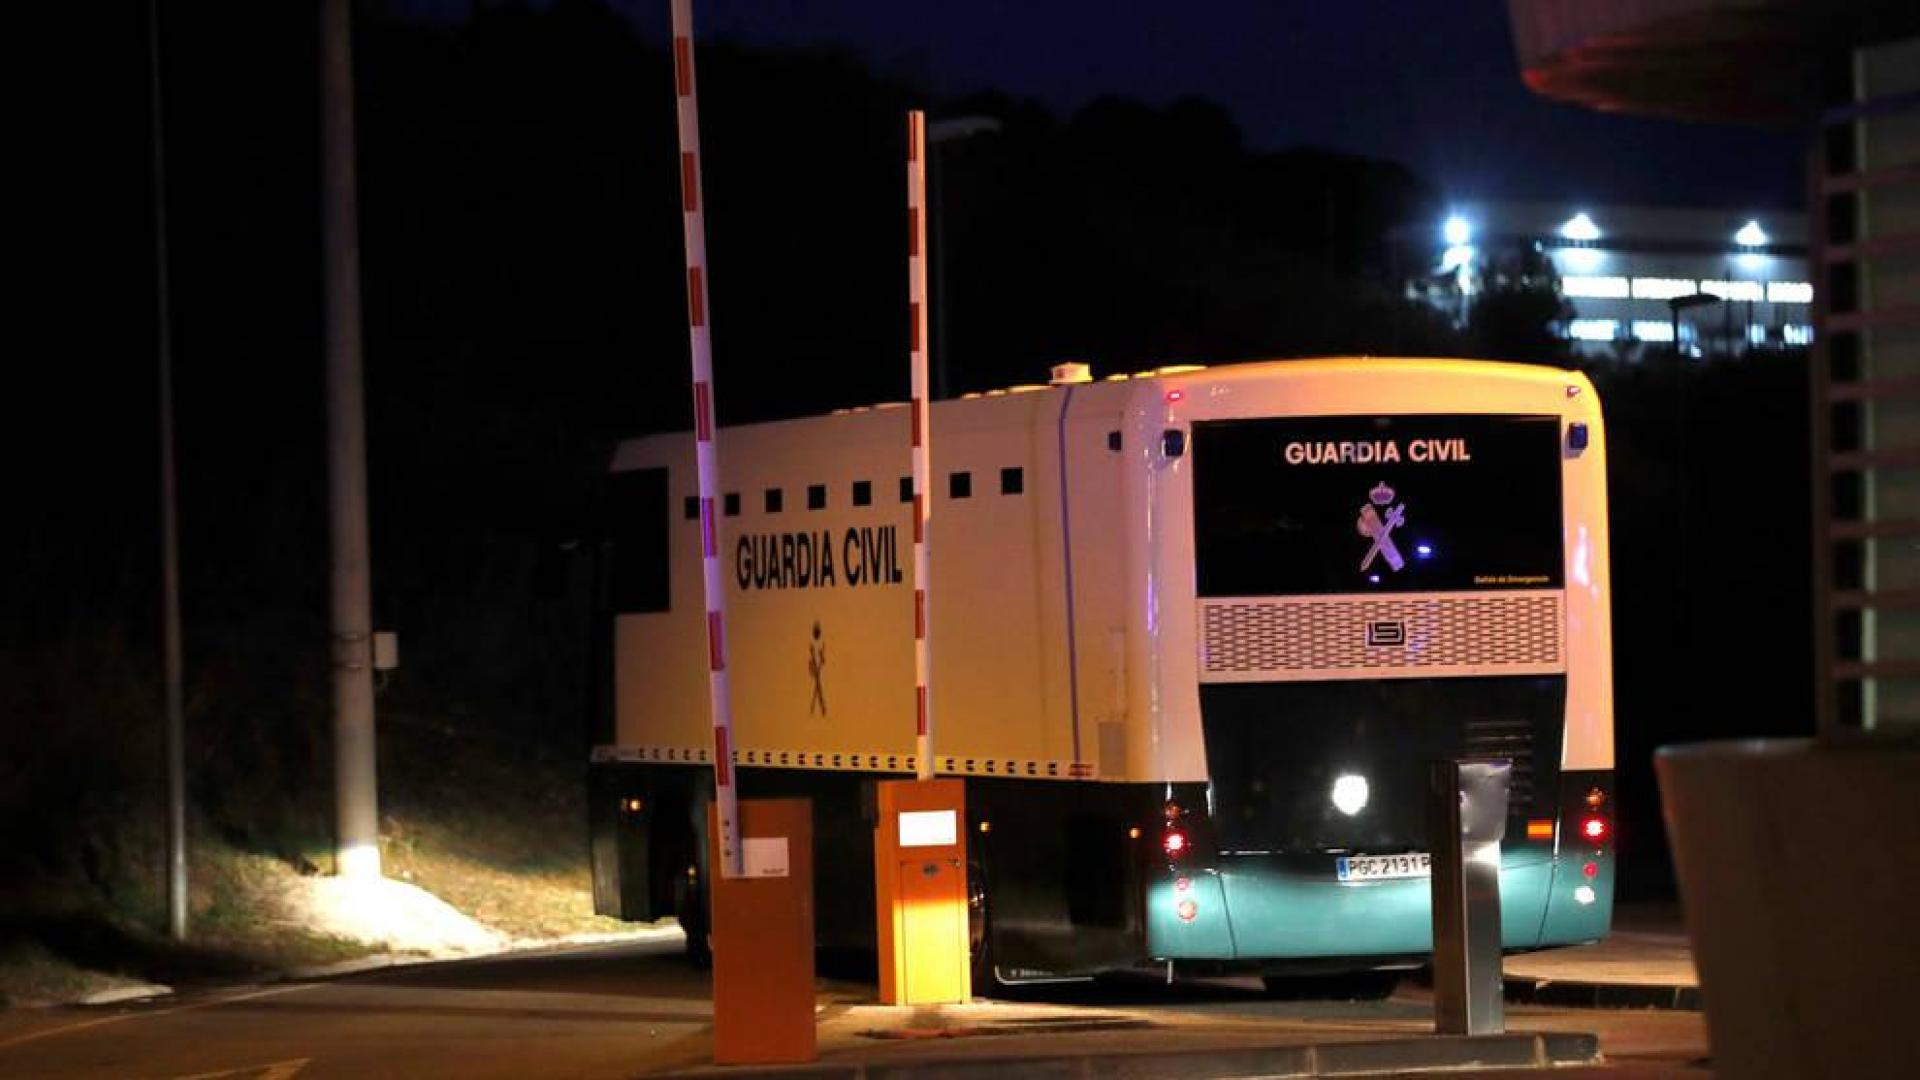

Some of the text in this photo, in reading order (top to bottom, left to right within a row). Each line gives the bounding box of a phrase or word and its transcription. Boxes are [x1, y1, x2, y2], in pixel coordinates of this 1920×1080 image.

[1285, 438, 1471, 464] GUARDIA CIVIL
[736, 525, 903, 590] GUARDIA CIVIL
